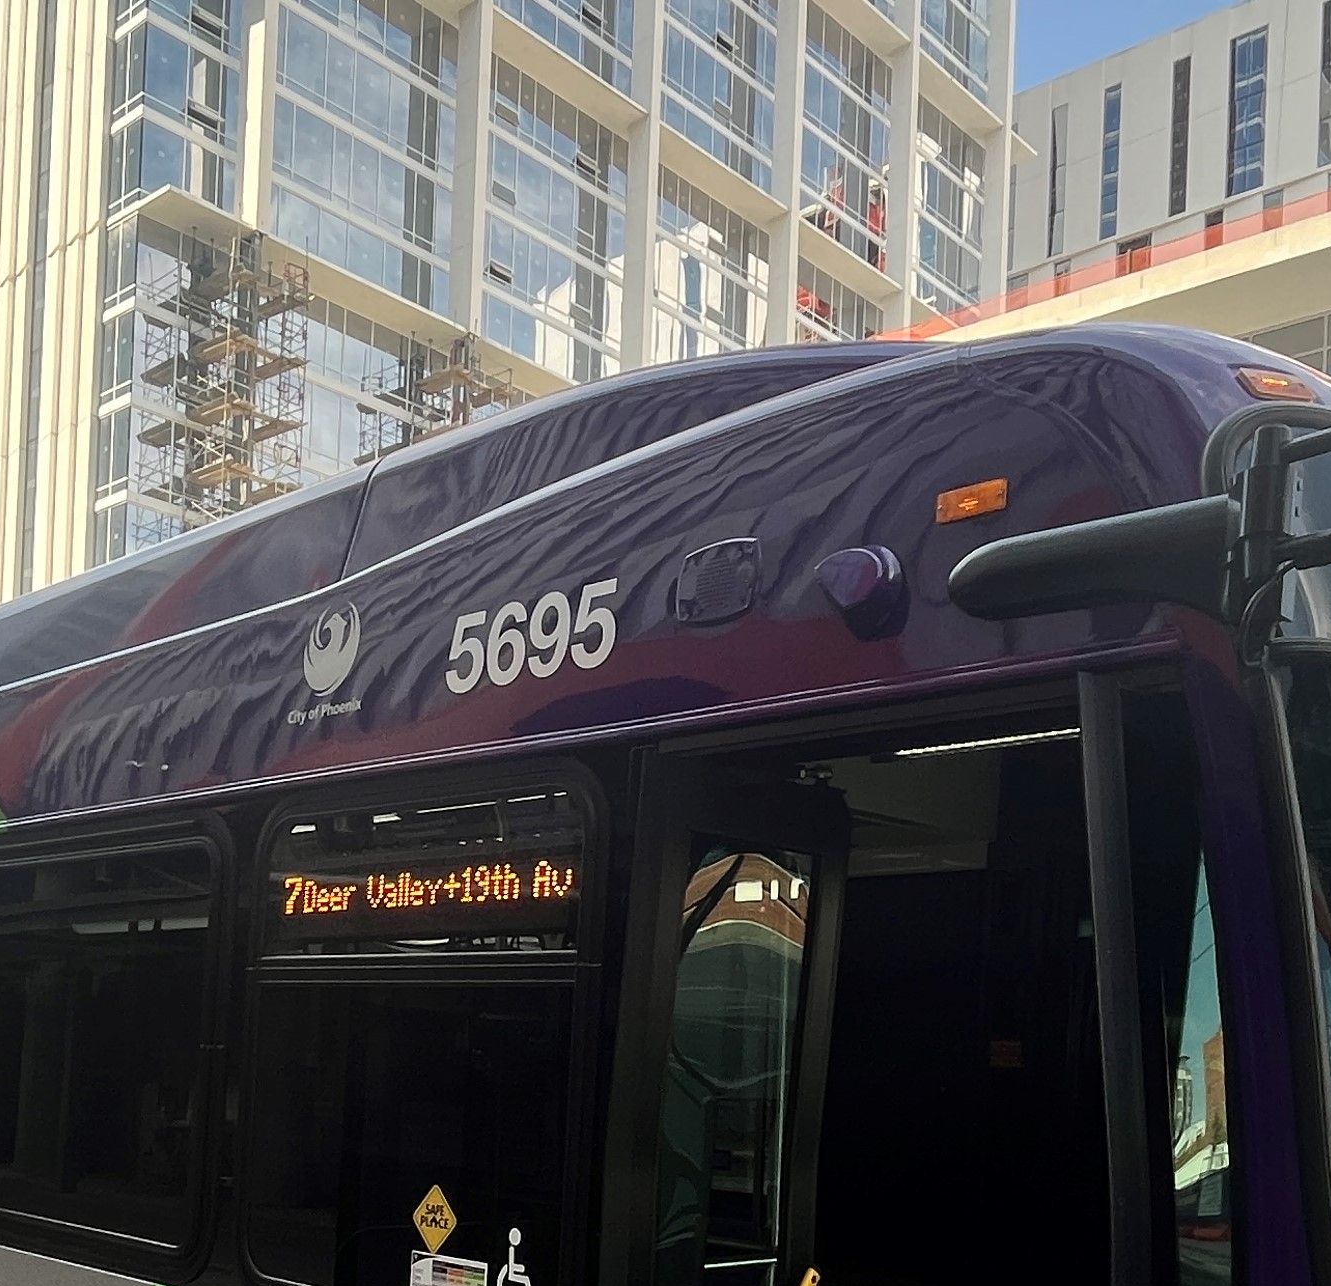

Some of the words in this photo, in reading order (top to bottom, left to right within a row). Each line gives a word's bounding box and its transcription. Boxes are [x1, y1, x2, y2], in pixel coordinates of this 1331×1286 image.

[445, 577, 618, 694] 5695
[287, 708, 306, 726] City
[307, 704, 320, 721] of
[320, 697, 363, 719] Phoenix
[531, 859, 574, 899] Av
[420, 1215, 450, 1230] PLACE
[425, 1203, 445, 1217] SAFE
